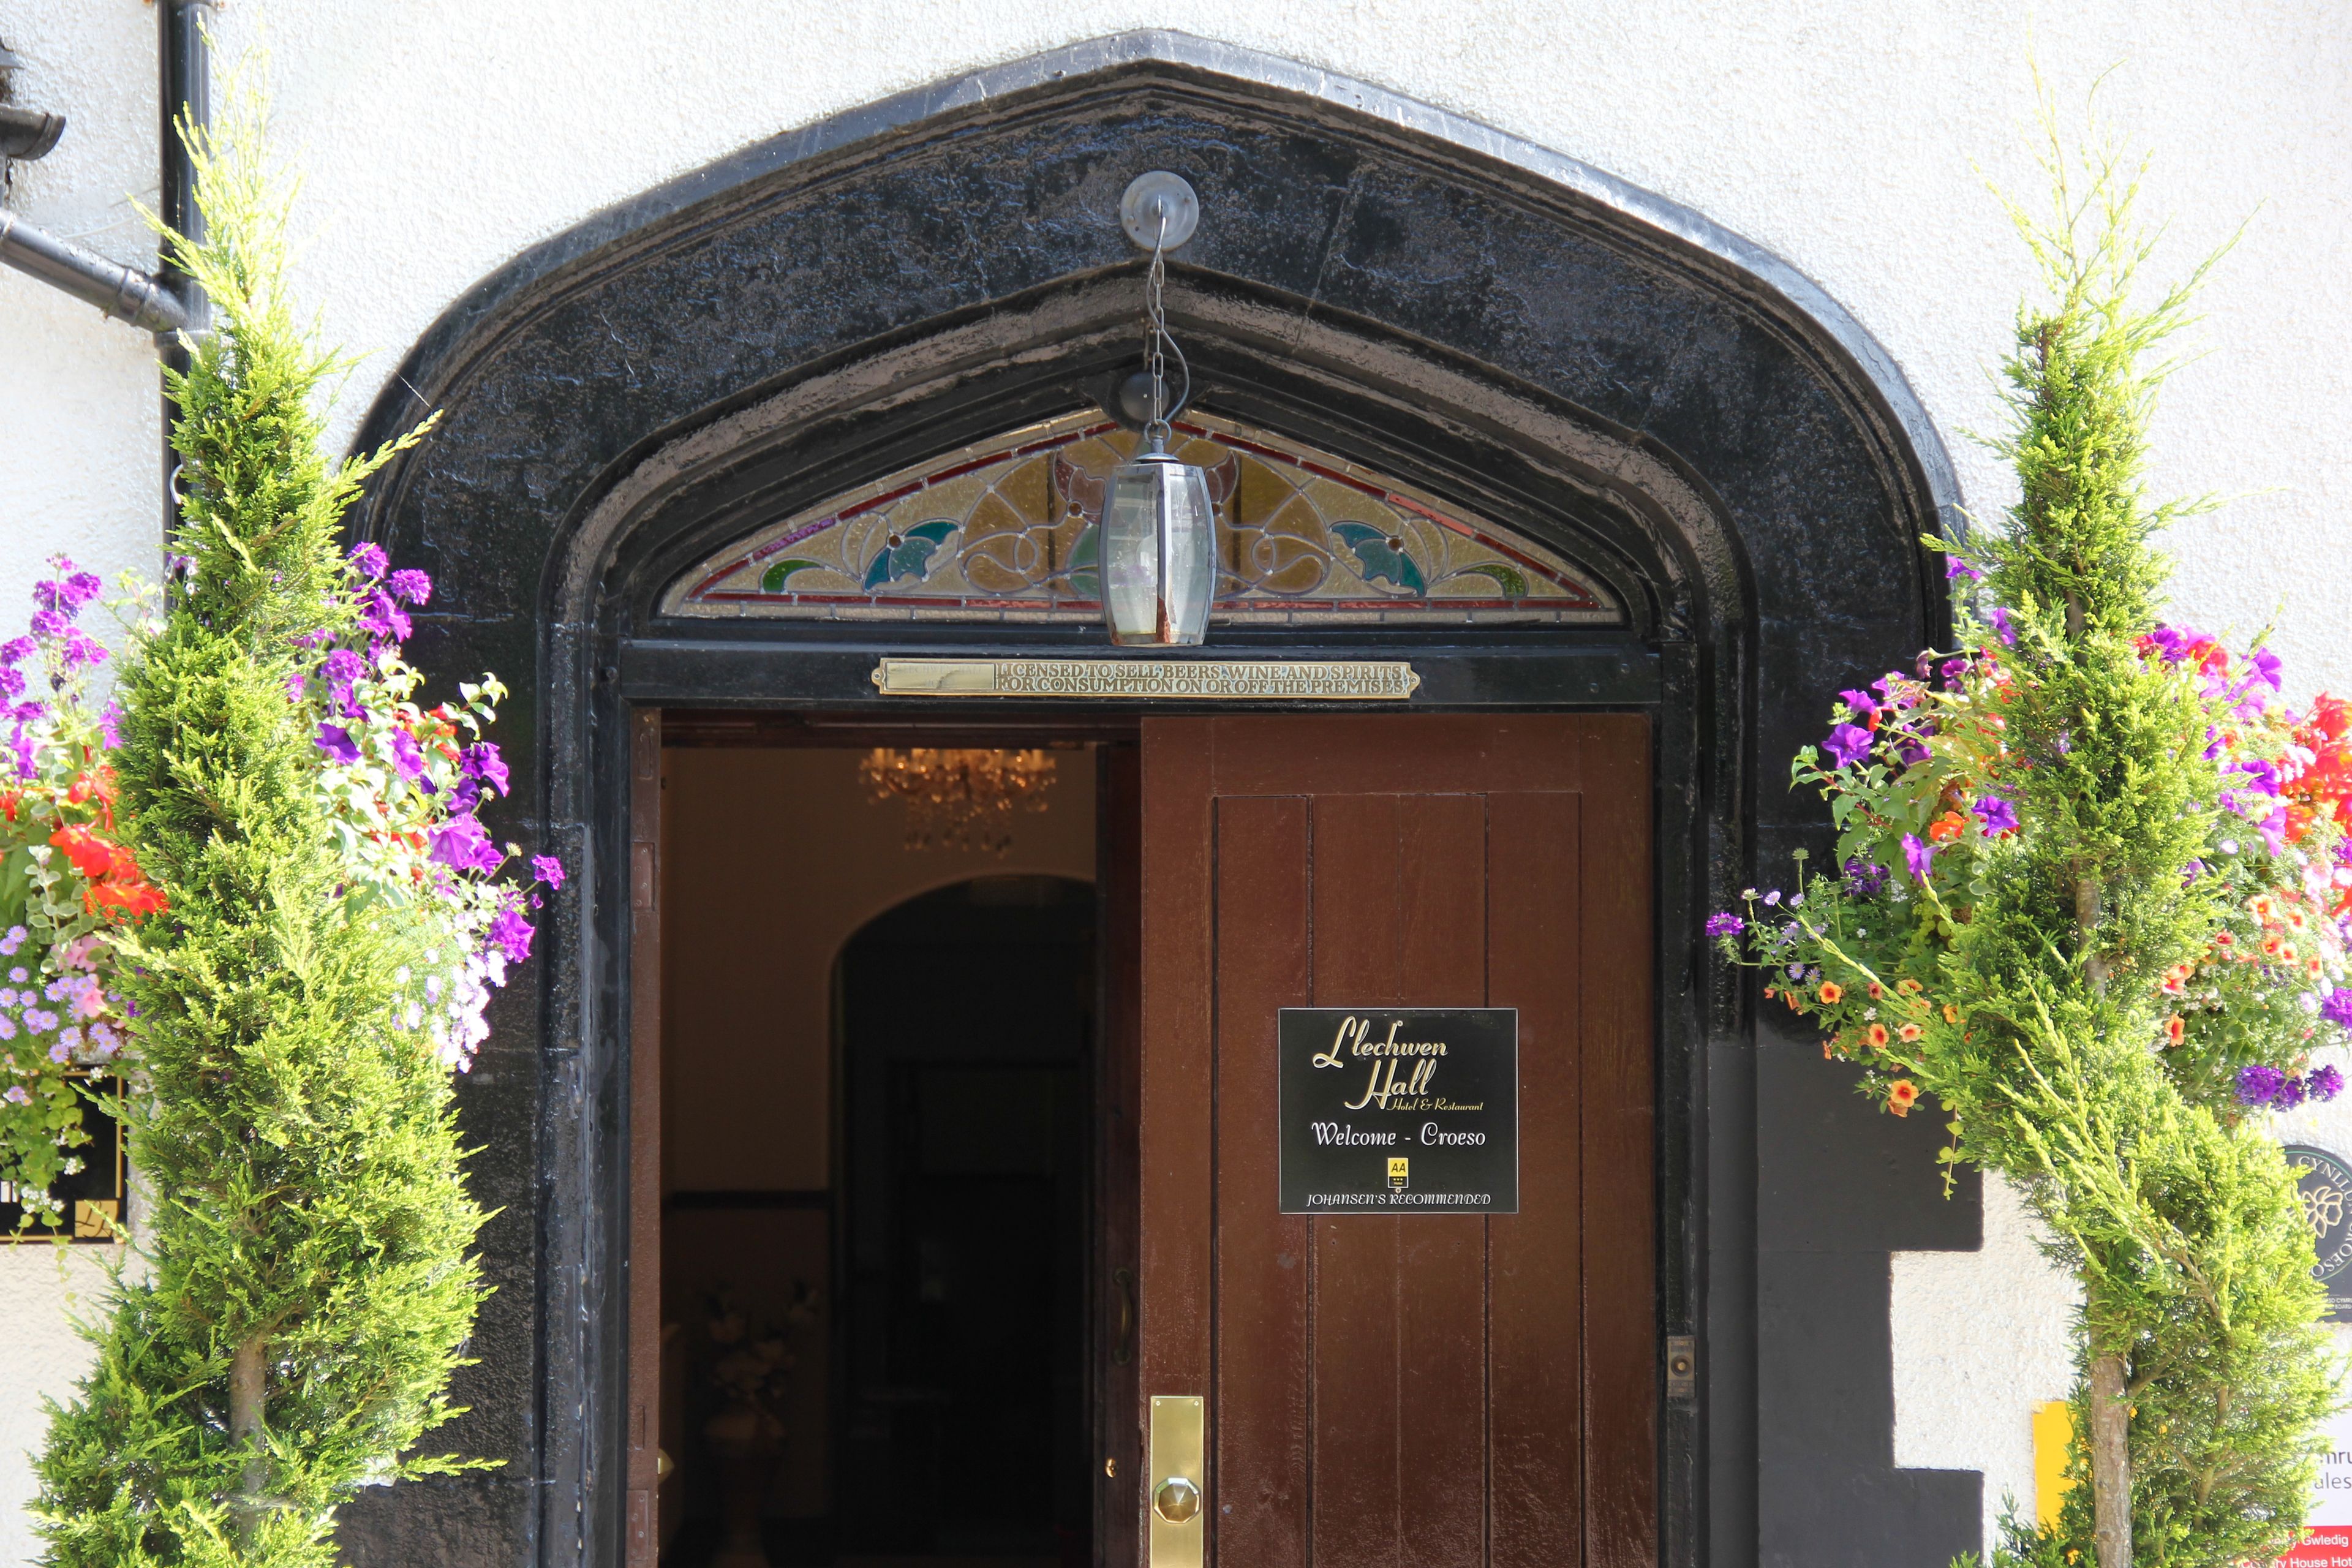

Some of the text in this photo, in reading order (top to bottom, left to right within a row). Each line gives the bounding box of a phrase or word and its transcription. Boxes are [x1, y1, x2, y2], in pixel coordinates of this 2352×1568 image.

[997, 663, 1083, 677] LICENSED
[1087, 665, 1112, 677] TO
[1115, 665, 1159, 678] SELL
[1286, 666, 1328, 679] AND
[1330, 666, 1402, 680] SPIRITS
[996, 677, 1404, 693] FOR CONSUMPTION ON OR OFF THE PREMISES
[1312, 1016, 1449, 1068] Llechwen
[1344, 1058, 1437, 1110] Hall
[1386, 1098, 1483, 1111] Hotel & Restaurant
[1311, 1122, 1396, 1146] Welcome
[1421, 1122, 1486, 1146] Croeso
[1391, 1163, 1406, 1172] AA
[1390, 1194, 1491, 1205] RECOMMENDED
[2302, 1535, 2349, 1548] Gwledig
[2290, 1558, 2328, 1568] House
